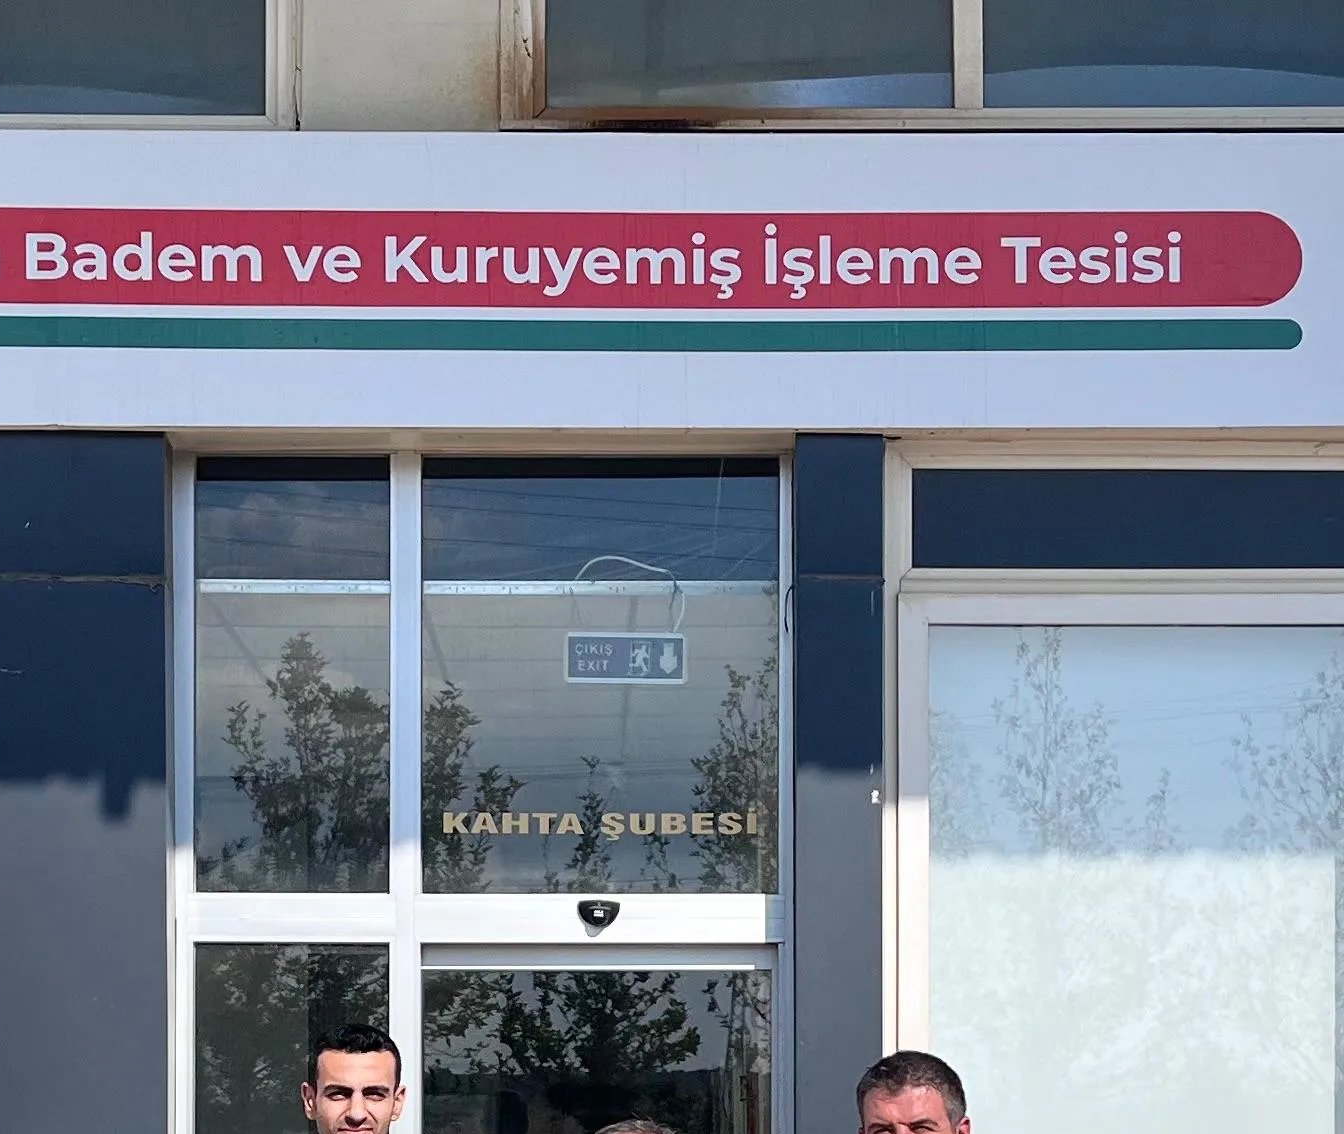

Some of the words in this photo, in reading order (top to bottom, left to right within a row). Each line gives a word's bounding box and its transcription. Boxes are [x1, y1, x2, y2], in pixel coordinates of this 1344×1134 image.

[24, 231, 263, 283] Badem
[282, 243, 362, 284] ve
[385, 231, 743, 299] Kuruyemiş
[764, 222, 983, 299] İşleme
[1000, 231, 1182, 285] Tesisi
[574, 643, 614, 657] ÇIKIŞ
[577, 660, 610, 671] EXIT
[442, 811, 585, 835] KAHTA
[600, 808, 758, 841] ŞUBESİ
